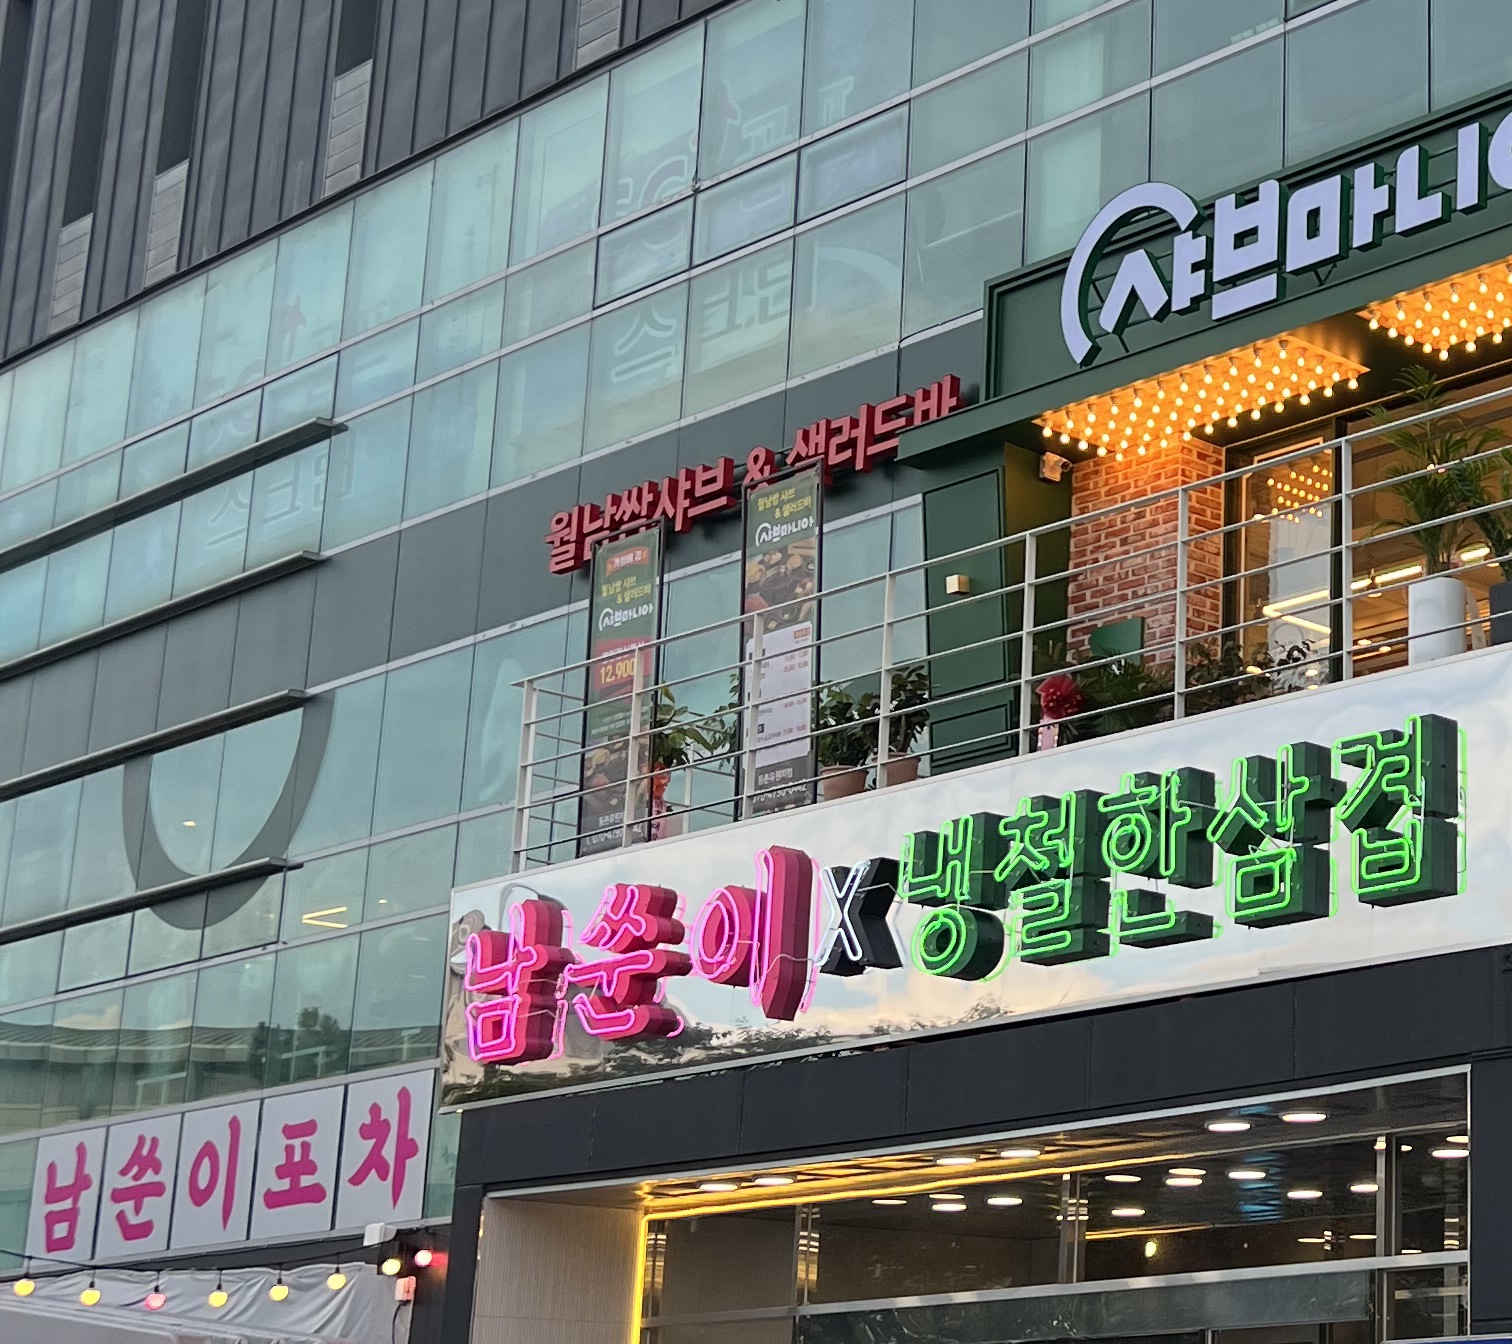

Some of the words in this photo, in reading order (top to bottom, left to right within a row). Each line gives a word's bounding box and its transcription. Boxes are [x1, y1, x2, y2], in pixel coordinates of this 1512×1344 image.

[755, 516, 815, 547] 샤브마니아
[598, 603, 654, 632] 샤브마니아
[900, 713, 1467, 982] 냉철한삼겹
